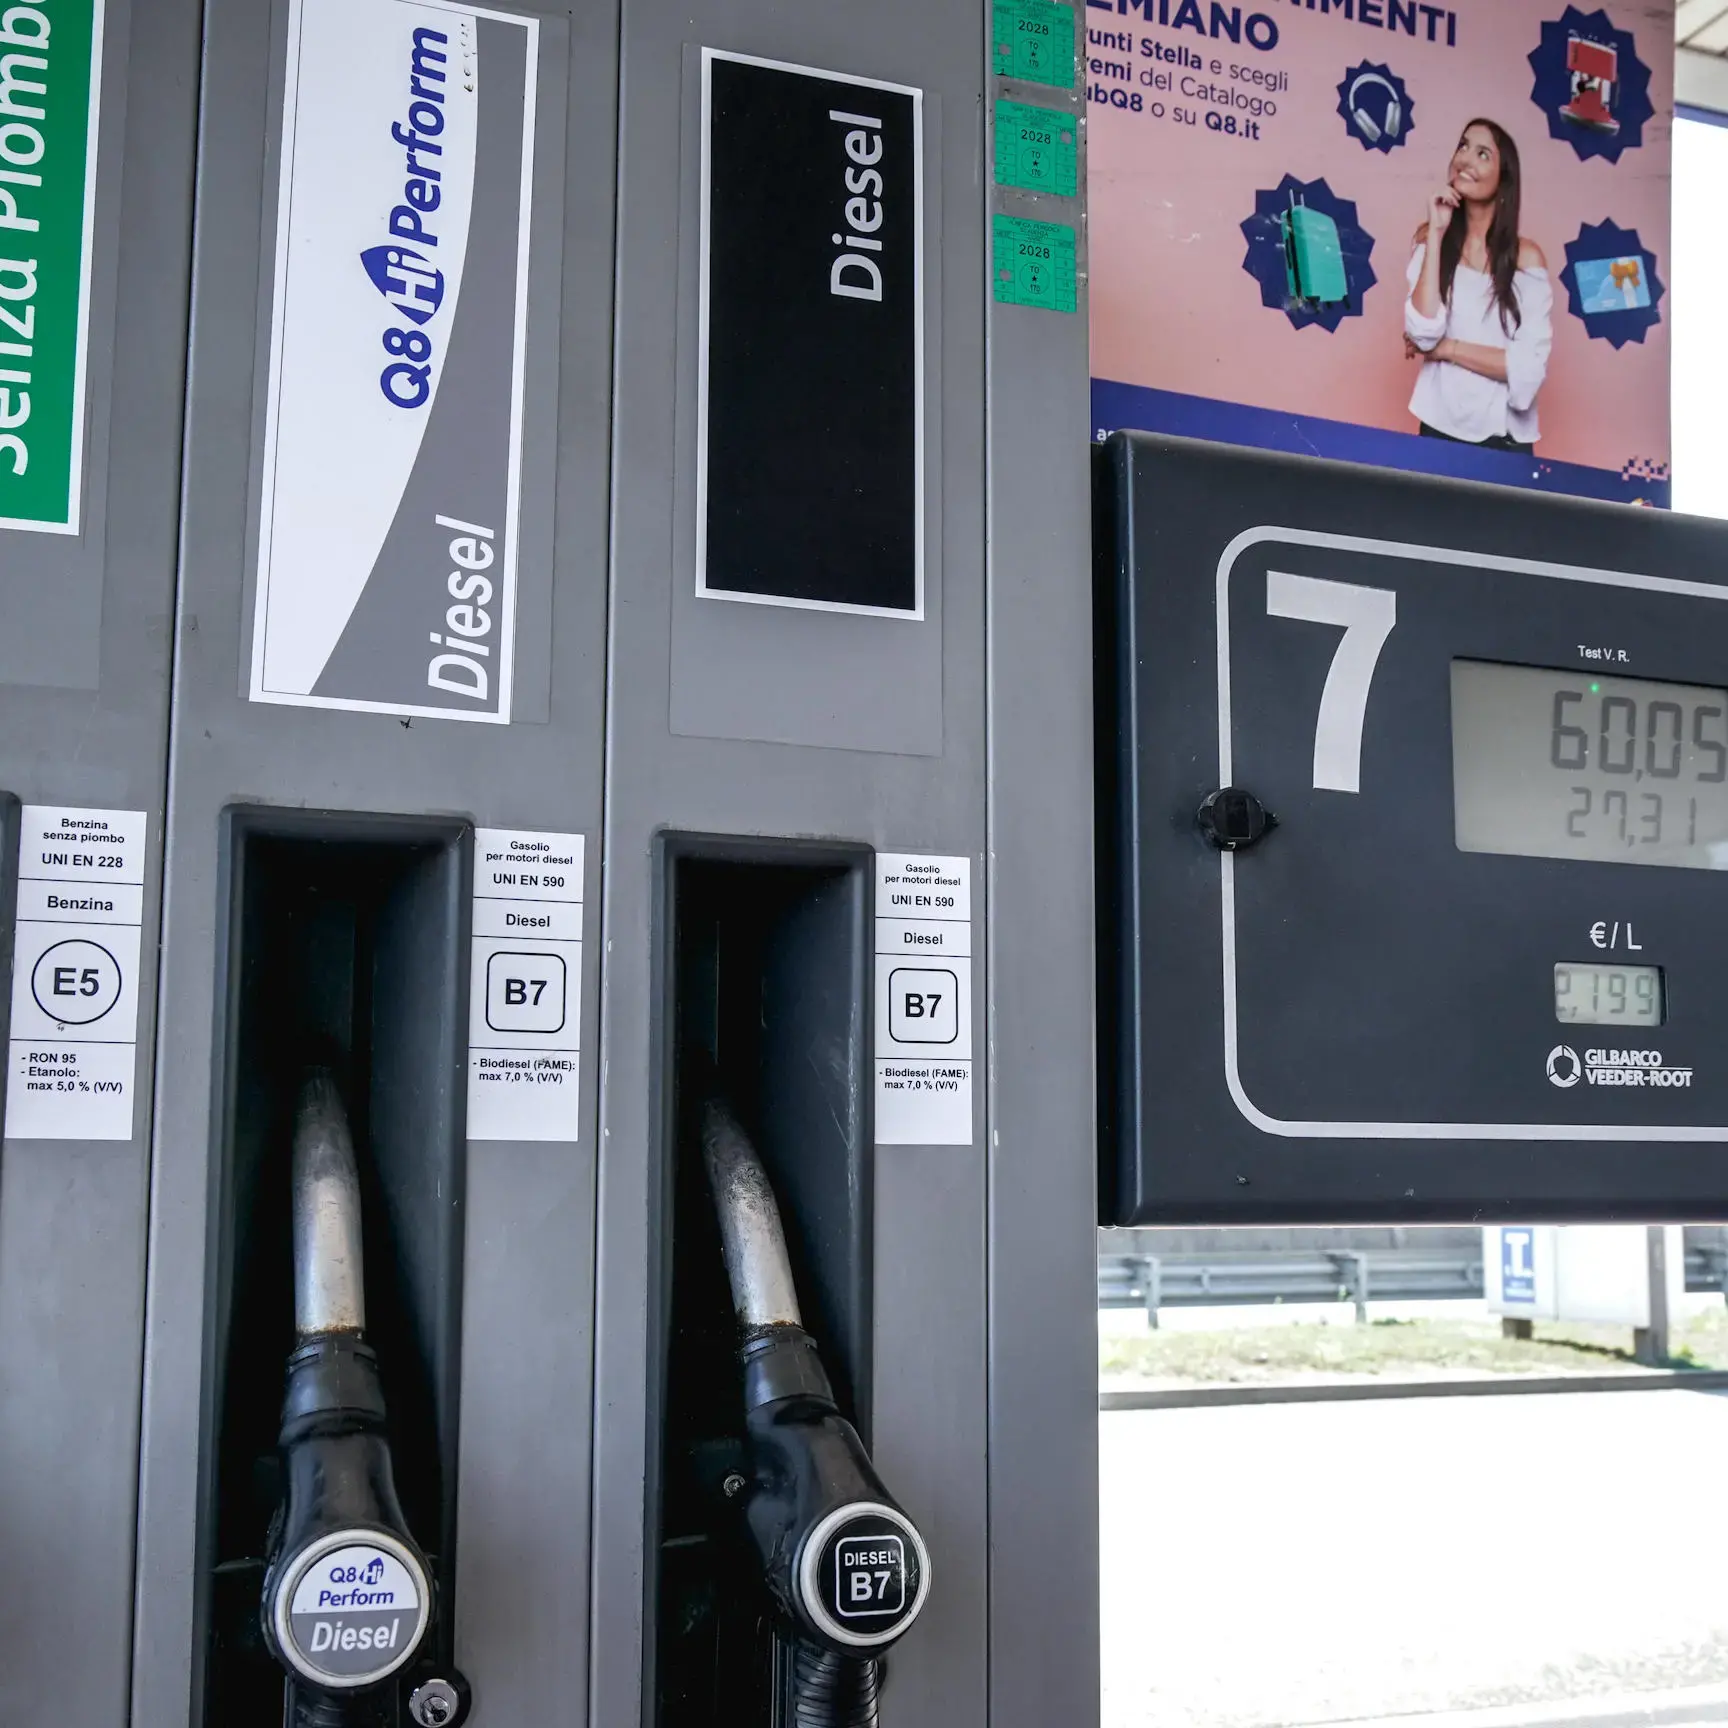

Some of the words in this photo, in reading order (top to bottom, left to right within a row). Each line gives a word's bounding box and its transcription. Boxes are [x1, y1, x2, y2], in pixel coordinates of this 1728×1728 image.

[1018, 20, 1049, 35] 2028
[1087, 0, 1279, 51] MIANO
[1140, 37, 1202, 70] Stella
[1210, 59, 1222, 75] e
[1229, 63, 1288, 92] scegli
[1140, 67, 1172, 91] del
[1180, 76, 1277, 117] Catalogo
[0, 0, 52, 233] Piomb
[1151, 102, 1165, 118] o
[1172, 107, 1196, 126] su
[1205, 111, 1260, 140] Q8.it
[388, 27, 448, 247] Perform
[1020, 129, 1051, 144] 2028
[828, 109, 883, 302] Diesel
[1019, 244, 1050, 259] 2028
[379, 327, 432, 409] Q8
[427, 514, 496, 700] Diesel
[1577, 644, 1602, 660] Test
[1603, 648, 1615, 661] V.
[1618, 649, 1630, 662] R.
[1266, 571, 1396, 793] 7
[1551, 690, 1726, 783] 60,05
[61, 818, 108, 829] Benzina
[1567, 786, 1697, 848] 27,31
[43, 831, 78, 841] senza
[81, 832, 124, 844] piombo
[510, 841, 549, 852] Gasolio
[42, 853, 67, 865] UNI
[73, 855, 94, 866] EN
[98, 856, 123, 868] 228
[486, 852, 503, 862] per
[506, 853, 540, 863] motori
[543, 854, 573, 865] diesel
[906, 864, 940, 874] Gasolio
[493, 874, 516, 885] UNI
[520, 875, 539, 886] EN
[543, 876, 564, 888] 590
[885, 875, 900, 884] per
[903, 876, 932, 884] motori
[934, 877, 961, 886] diesel
[48, 895, 113, 911] Benzina
[892, 895, 911, 905] UNI
[916, 895, 931, 906] EN
[935, 896, 954, 907] 590
[506, 914, 550, 927] Diesel
[904, 932, 943, 944] Diesel
[53, 967, 99, 997] E5
[505, 979, 547, 1005] B7
[906, 993, 942, 1018] B7
[30, 1053, 58, 1063] RON
[62, 1054, 76, 1063] 95
[480, 1058, 530, 1069] Biodiesel
[533, 1059, 575, 1071] (FAME):
[1584, 1049, 1662, 1067] GILBARCO
[29, 1067, 80, 1077] Etanolo:
[479, 1073, 501, 1081] max
[505, 1072, 521, 1082] 7,0
[524, 1072, 533, 1082] %
[537, 1072, 562, 1084] (V/V)
[886, 1068, 929, 1077] Biodiesel
[932, 1069, 969, 1079] (FAME):
[1585, 1069, 1693, 1087] VEEDER-ROOT
[27, 1082, 53, 1091] max
[57, 1081, 74, 1092] 5,0
[79, 1082, 89, 1091] %
[94, 1082, 123, 1094] (V/V)
[907, 1081, 921, 1090] 7,0
[924, 1081, 932, 1089] %
[935, 1081, 958, 1091] (V/V)
[845, 1551, 896, 1567] DIESEL
[330, 1567, 356, 1583] Q8
[851, 1571, 891, 1601] B7
[319, 1589, 394, 1606] Perform
[310, 1618, 400, 1652] Diesel
